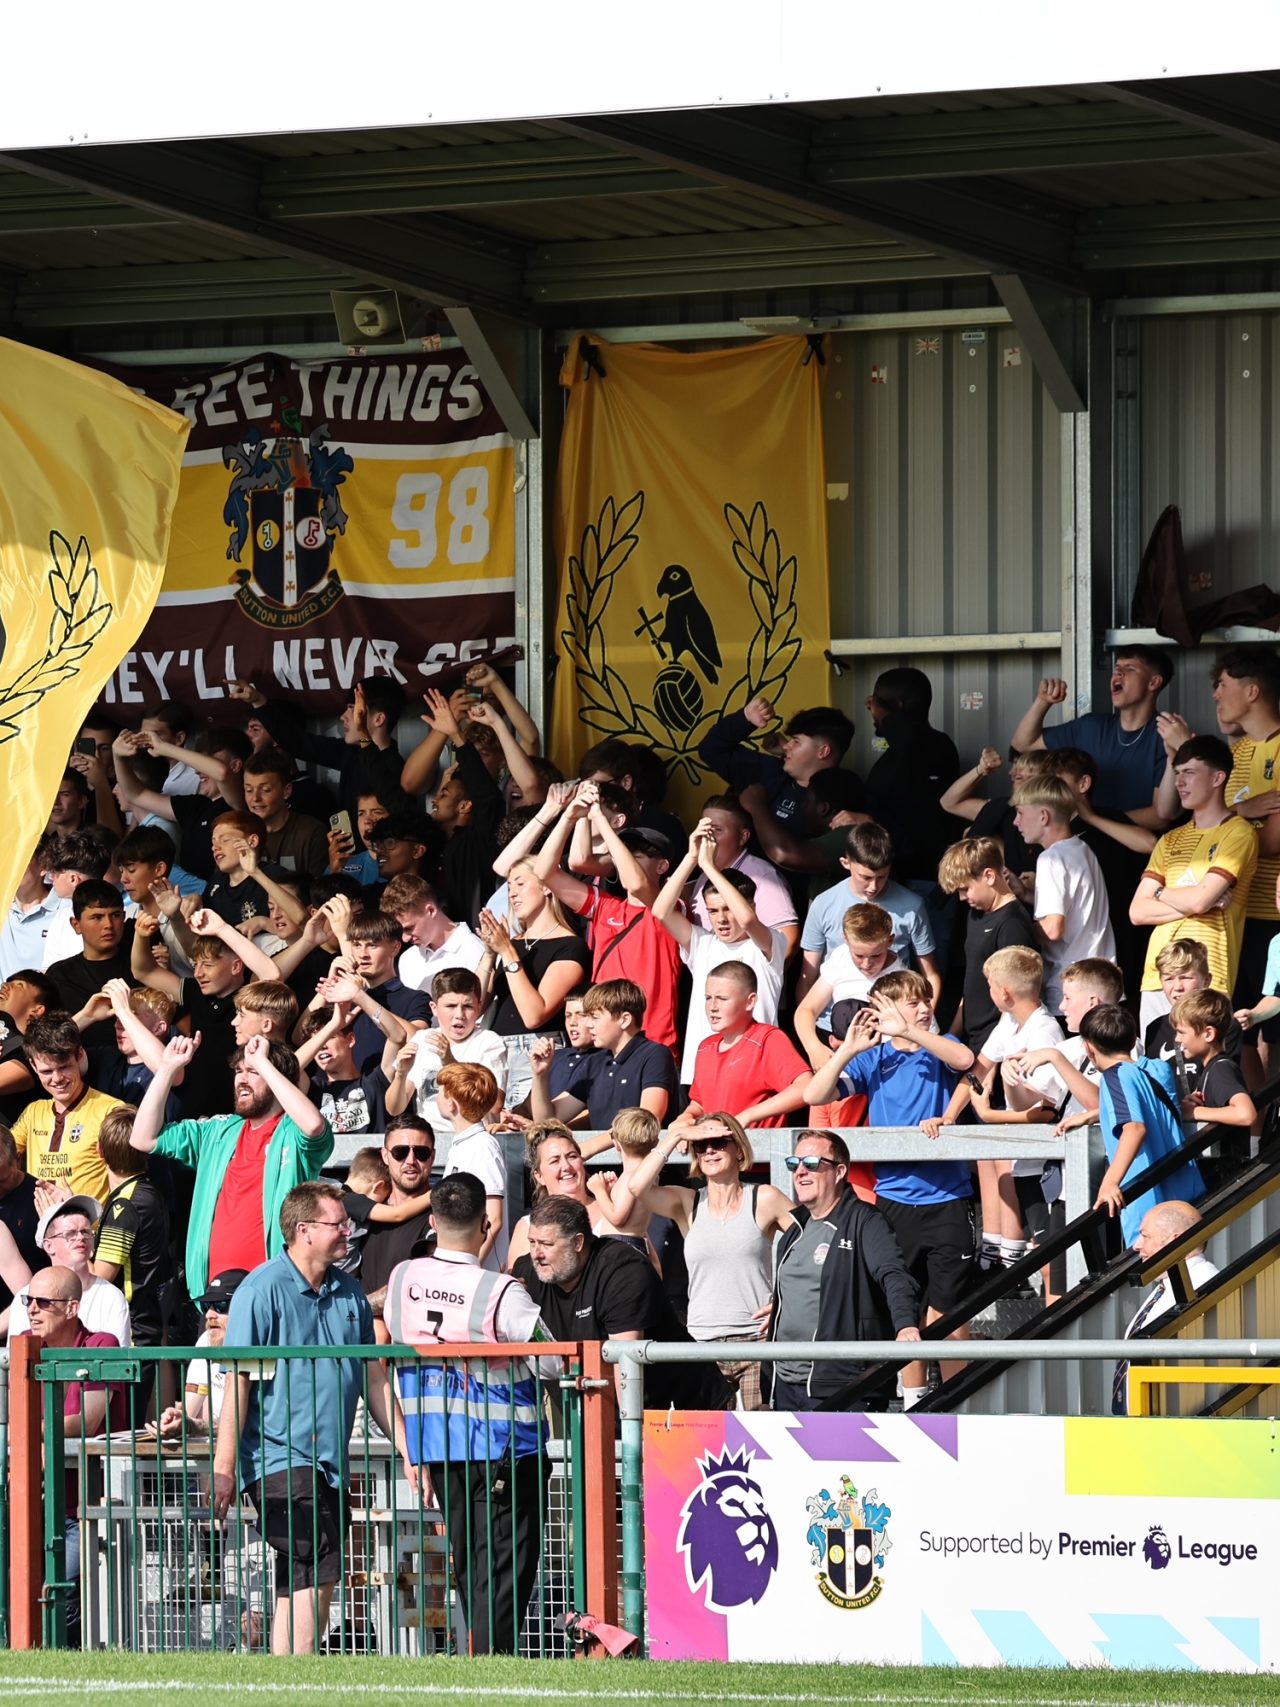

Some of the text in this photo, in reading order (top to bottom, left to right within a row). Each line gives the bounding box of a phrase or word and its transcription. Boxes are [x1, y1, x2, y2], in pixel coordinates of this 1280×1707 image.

[171, 362, 483, 428] SEE THINGS
[388, 467, 490, 569] 98
[240, 588, 278, 624] SUTTON
[281, 602, 319, 625] UNITED
[425, 1288, 465, 1305] LORDS
[426, 1310, 446, 1344] 7
[919, 1531, 1258, 1566] Supported by Premier League
[820, 1582, 844, 1606] SUTTON
[845, 1596, 870, 1607] UNITED
